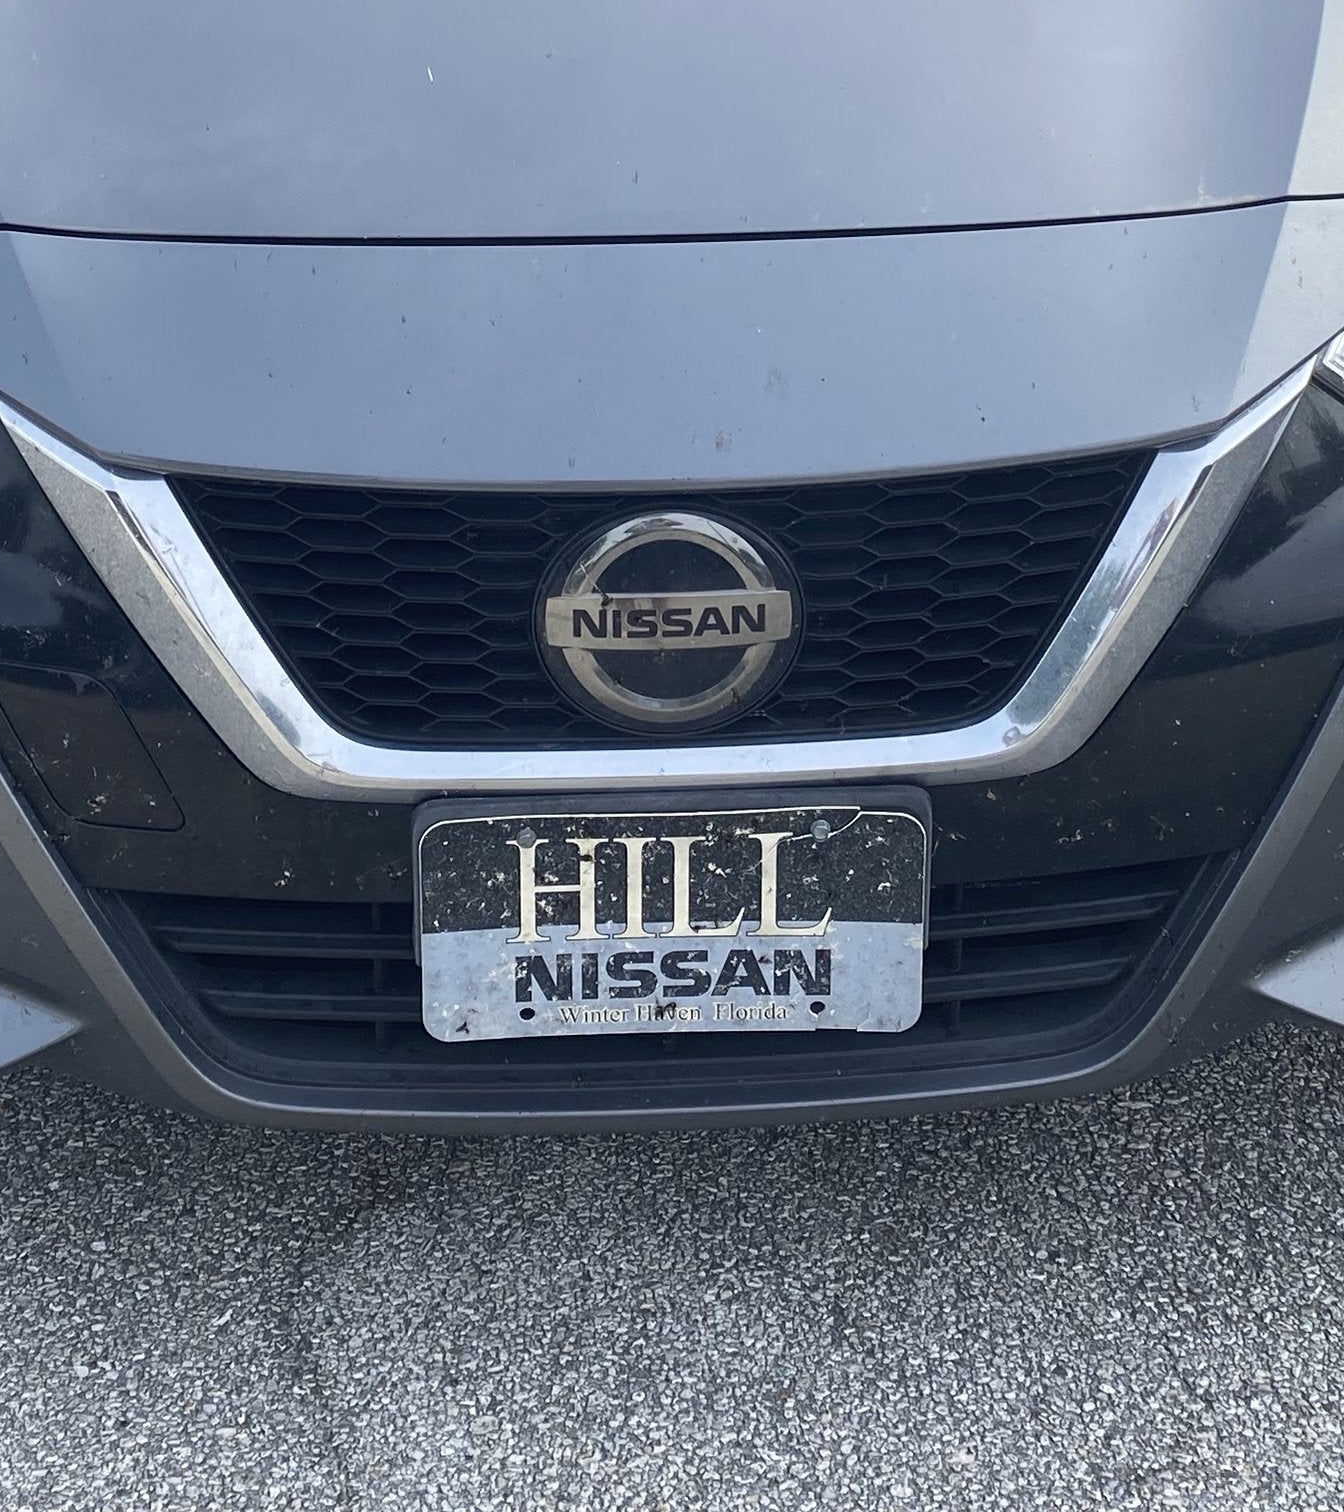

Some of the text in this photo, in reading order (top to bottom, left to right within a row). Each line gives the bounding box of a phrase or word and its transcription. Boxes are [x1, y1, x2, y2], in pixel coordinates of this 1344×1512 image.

[573, 603, 766, 638] NISSAN
[506, 832, 833, 944] HILL
[515, 948, 831, 1003] NISSAN
[559, 1005, 630, 1024] Winter
[713, 1000, 787, 1021] Florida
